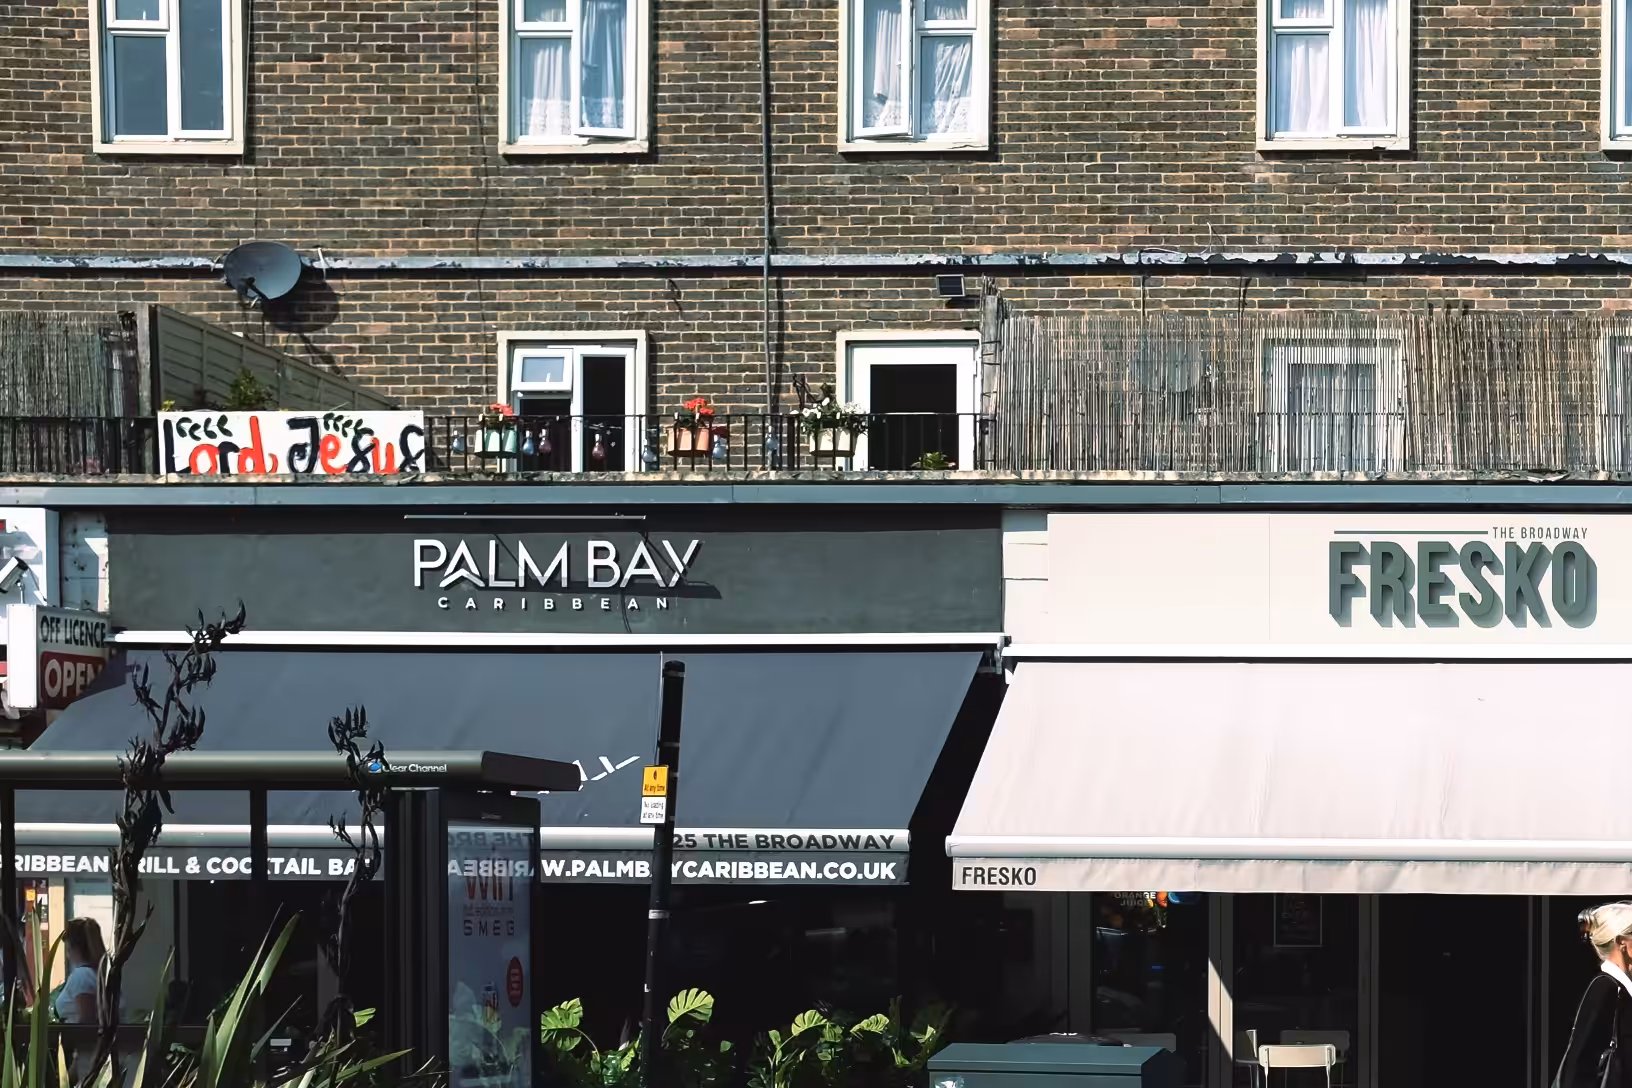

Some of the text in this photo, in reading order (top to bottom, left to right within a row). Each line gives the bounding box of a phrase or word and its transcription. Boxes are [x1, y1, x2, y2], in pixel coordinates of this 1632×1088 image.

[286, 417, 425, 474] Jesus
[1492, 526, 1589, 540] THE BROADWAY
[413, 538, 700, 589] PALM BAY
[1328, 540, 1598, 629] FRESKO
[437, 596, 668, 610] CARIBBEAN
[40, 615, 61, 644] OFF
[408, 763, 447, 773] Channel
[673, 833, 896, 850] 25 THE BROADWAY
[0, 854, 371, 876] RIBBEAN RILL & COCTAIL BA
[962, 866, 1037, 886] FRESKO
